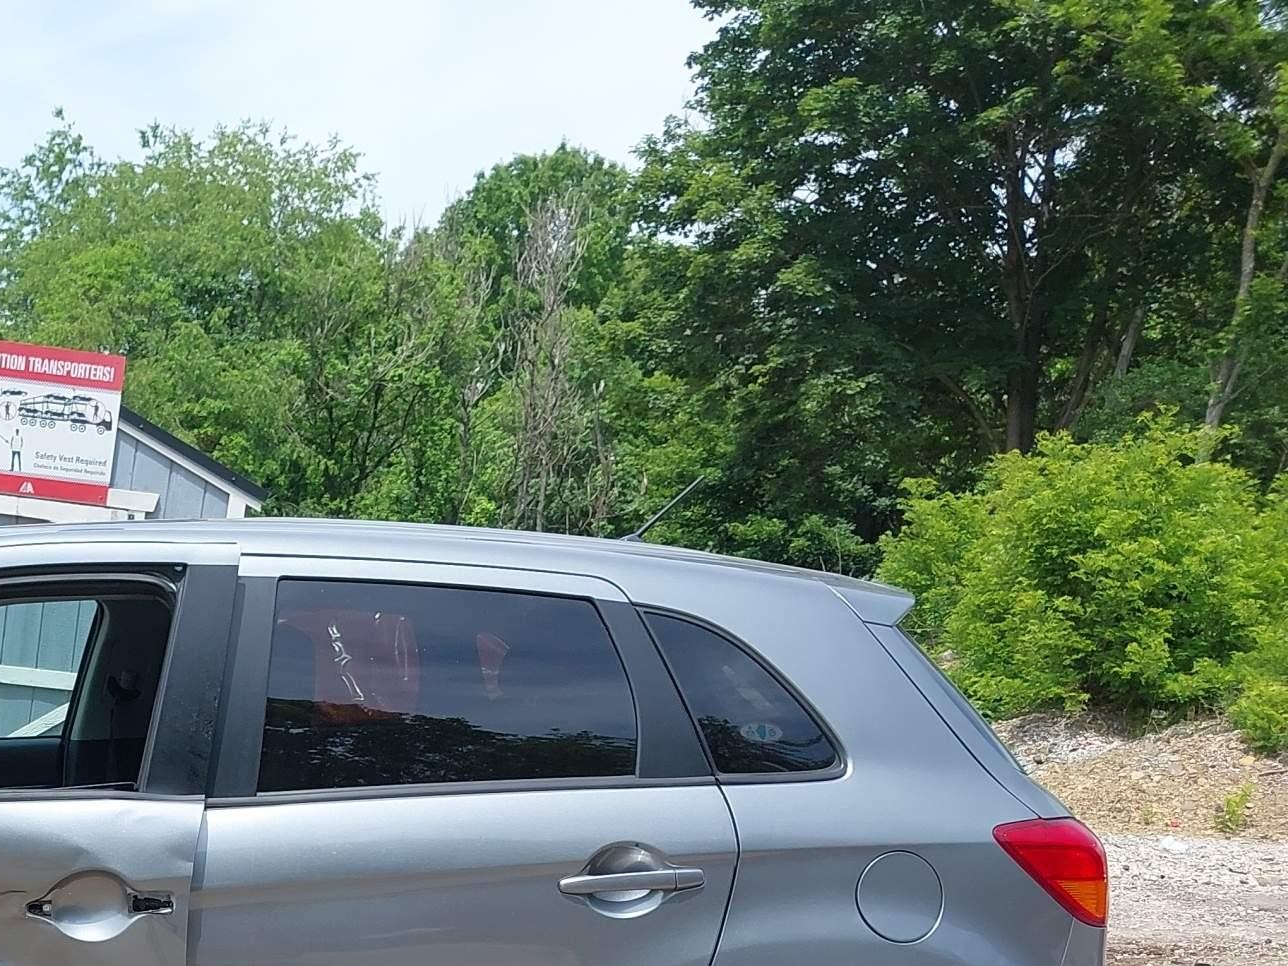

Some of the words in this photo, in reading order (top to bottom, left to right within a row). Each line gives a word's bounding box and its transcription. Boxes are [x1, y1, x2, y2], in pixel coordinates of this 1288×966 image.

[28, 357, 114, 382] TRANSPORTERS!
[35, 451, 57, 462] Safety
[59, 454, 73, 463] Vest
[75, 456, 107, 467] Required
